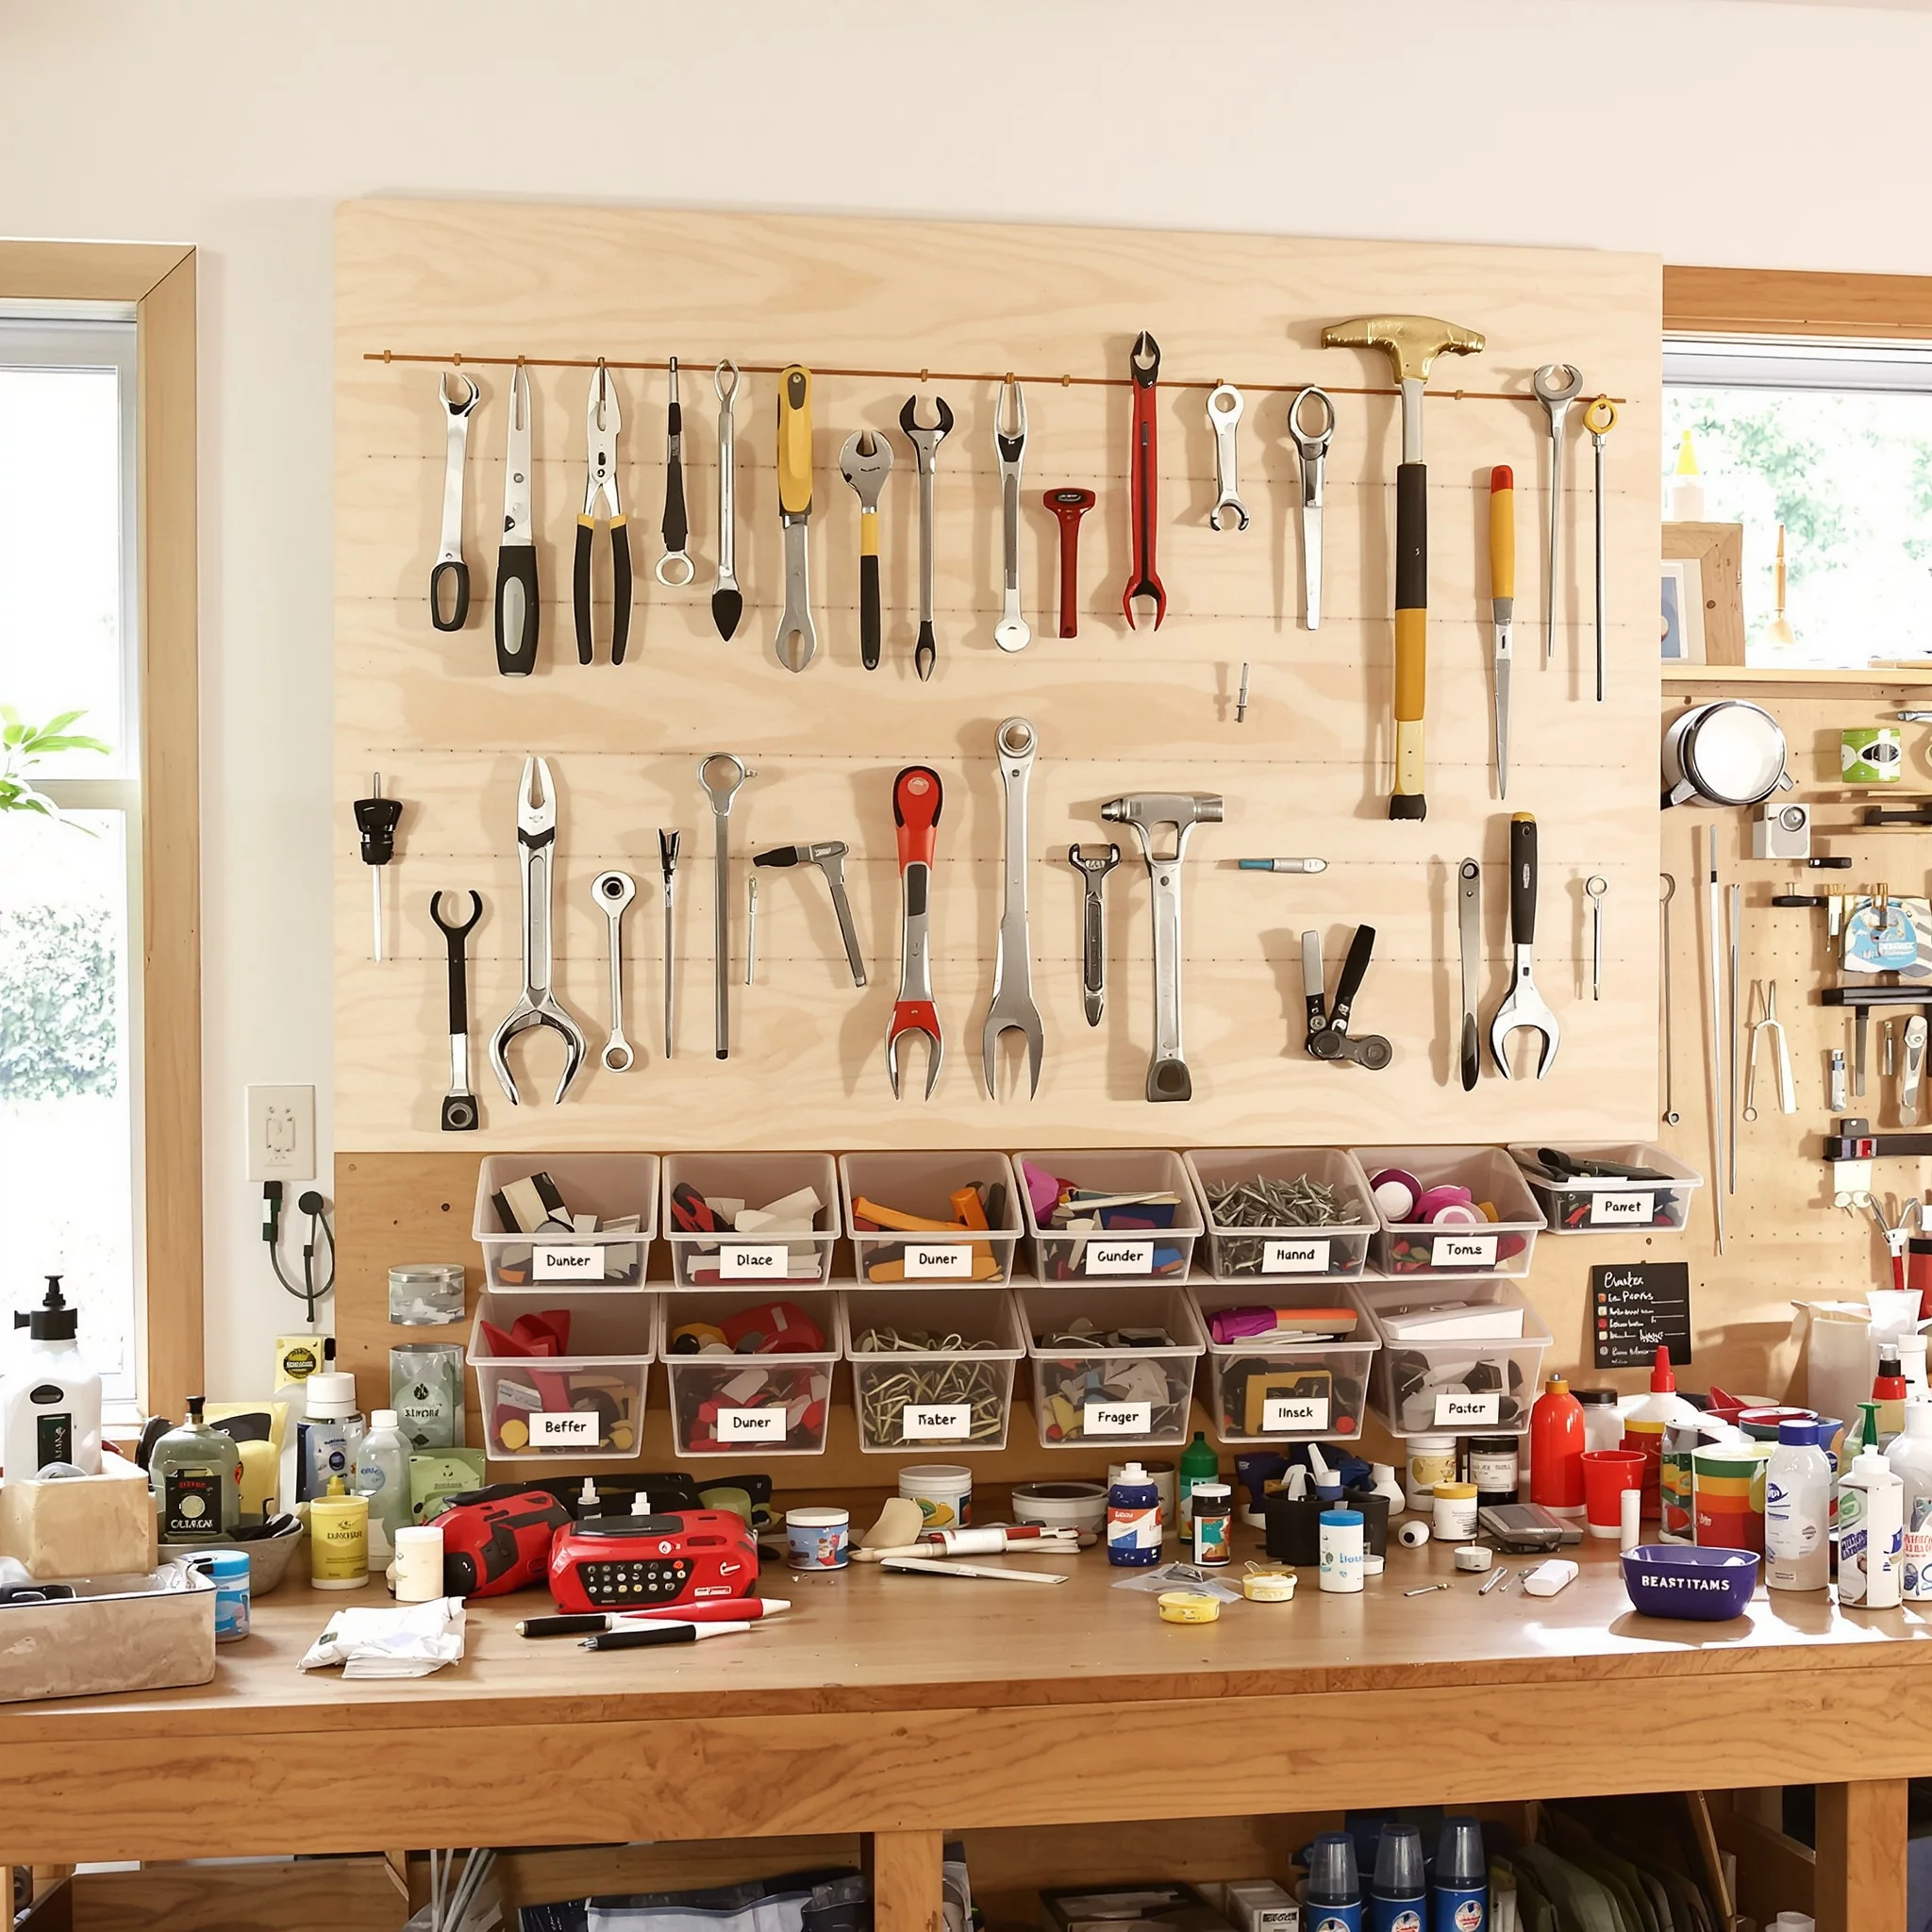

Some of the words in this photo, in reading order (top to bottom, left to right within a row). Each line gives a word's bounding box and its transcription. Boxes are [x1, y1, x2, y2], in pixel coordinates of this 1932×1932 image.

[919, 1252, 958, 1265] Duner
[733, 1416, 772, 1428] Duner
[1098, 1411, 1140, 1425] Frager
[545, 1420, 587, 1433] Beffer
